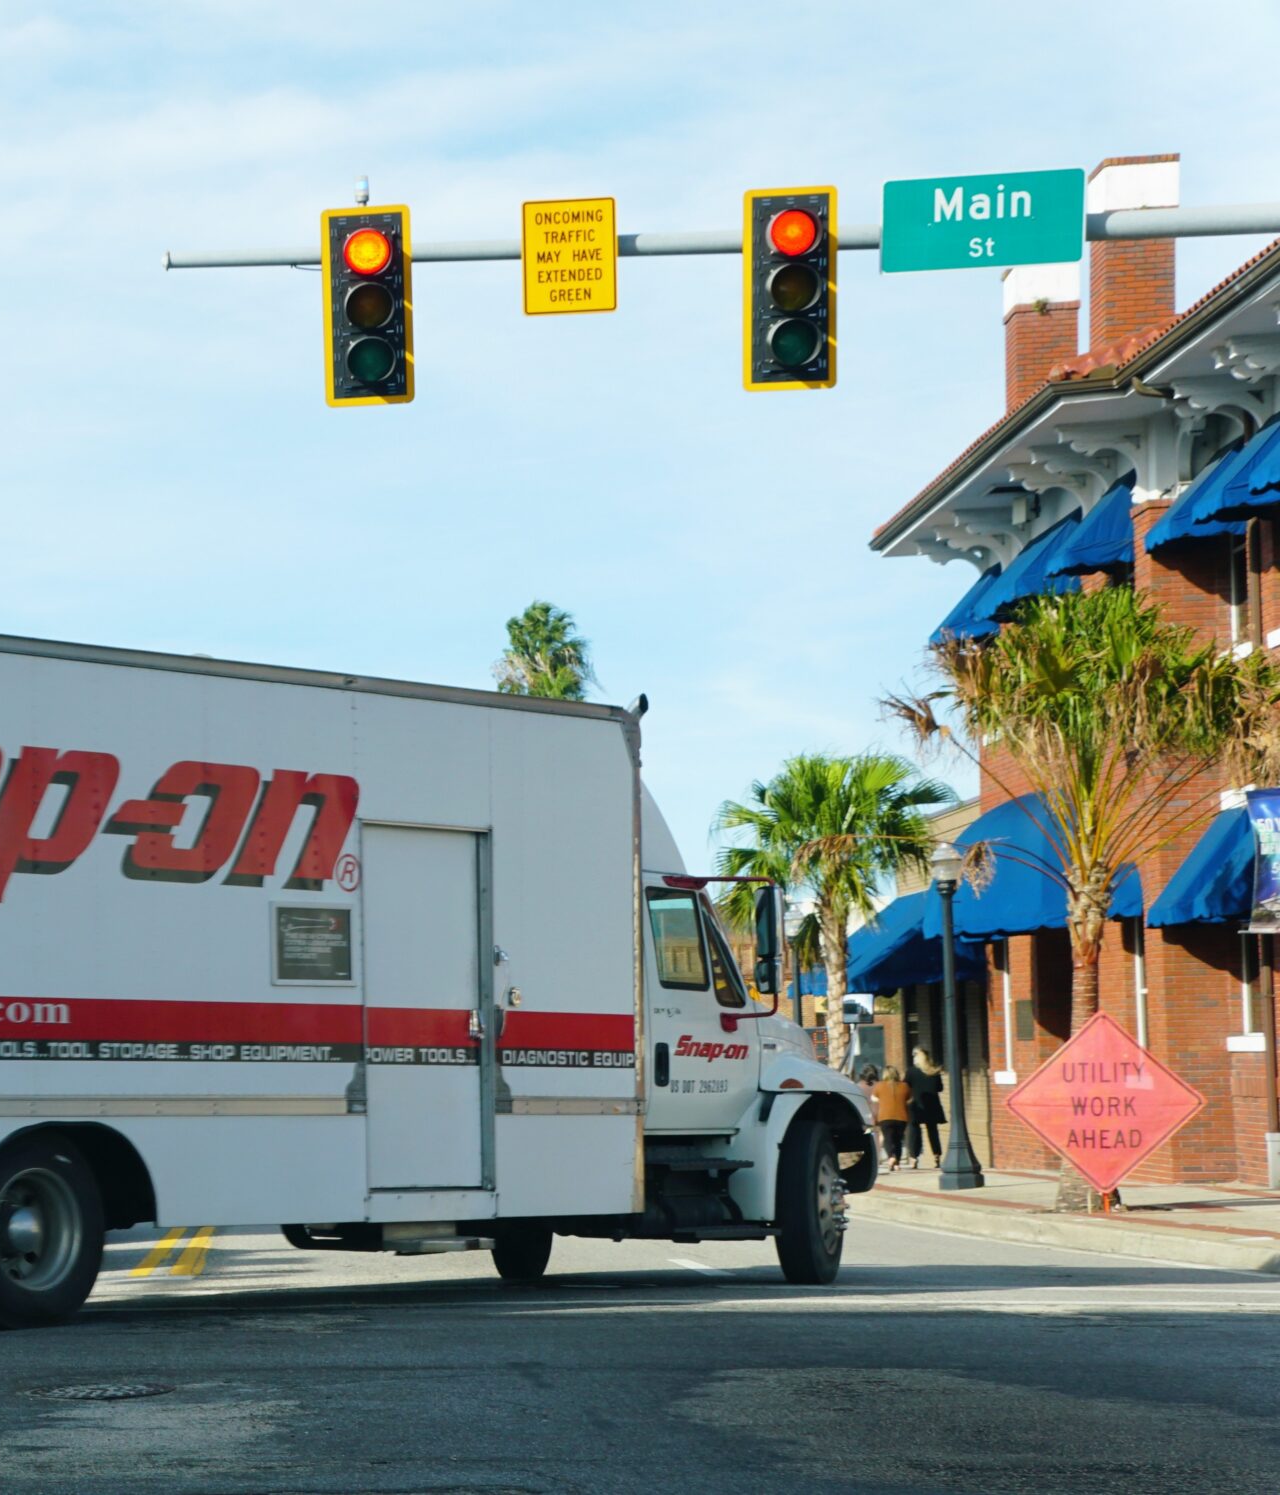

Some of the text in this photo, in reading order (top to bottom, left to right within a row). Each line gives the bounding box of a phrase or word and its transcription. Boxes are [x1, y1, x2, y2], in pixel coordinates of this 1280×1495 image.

[933, 184, 1032, 223] Main
[535, 209, 603, 225] ONCOMING
[544, 229, 595, 244] TRAFFIC
[537, 248, 602, 264] MAY HAVE
[969, 237, 995, 257] St
[538, 268, 602, 283] EXTENDED
[550, 288, 592, 302] GREEN
[674, 1035, 750, 1062] Snap-on
[502, 1050, 635, 1067] DIAGNOSTIC EQUIP
[1062, 1062, 1145, 1083] UTILITY
[1071, 1096, 1137, 1117] WORK
[1066, 1129, 1142, 1148] AHEAD
